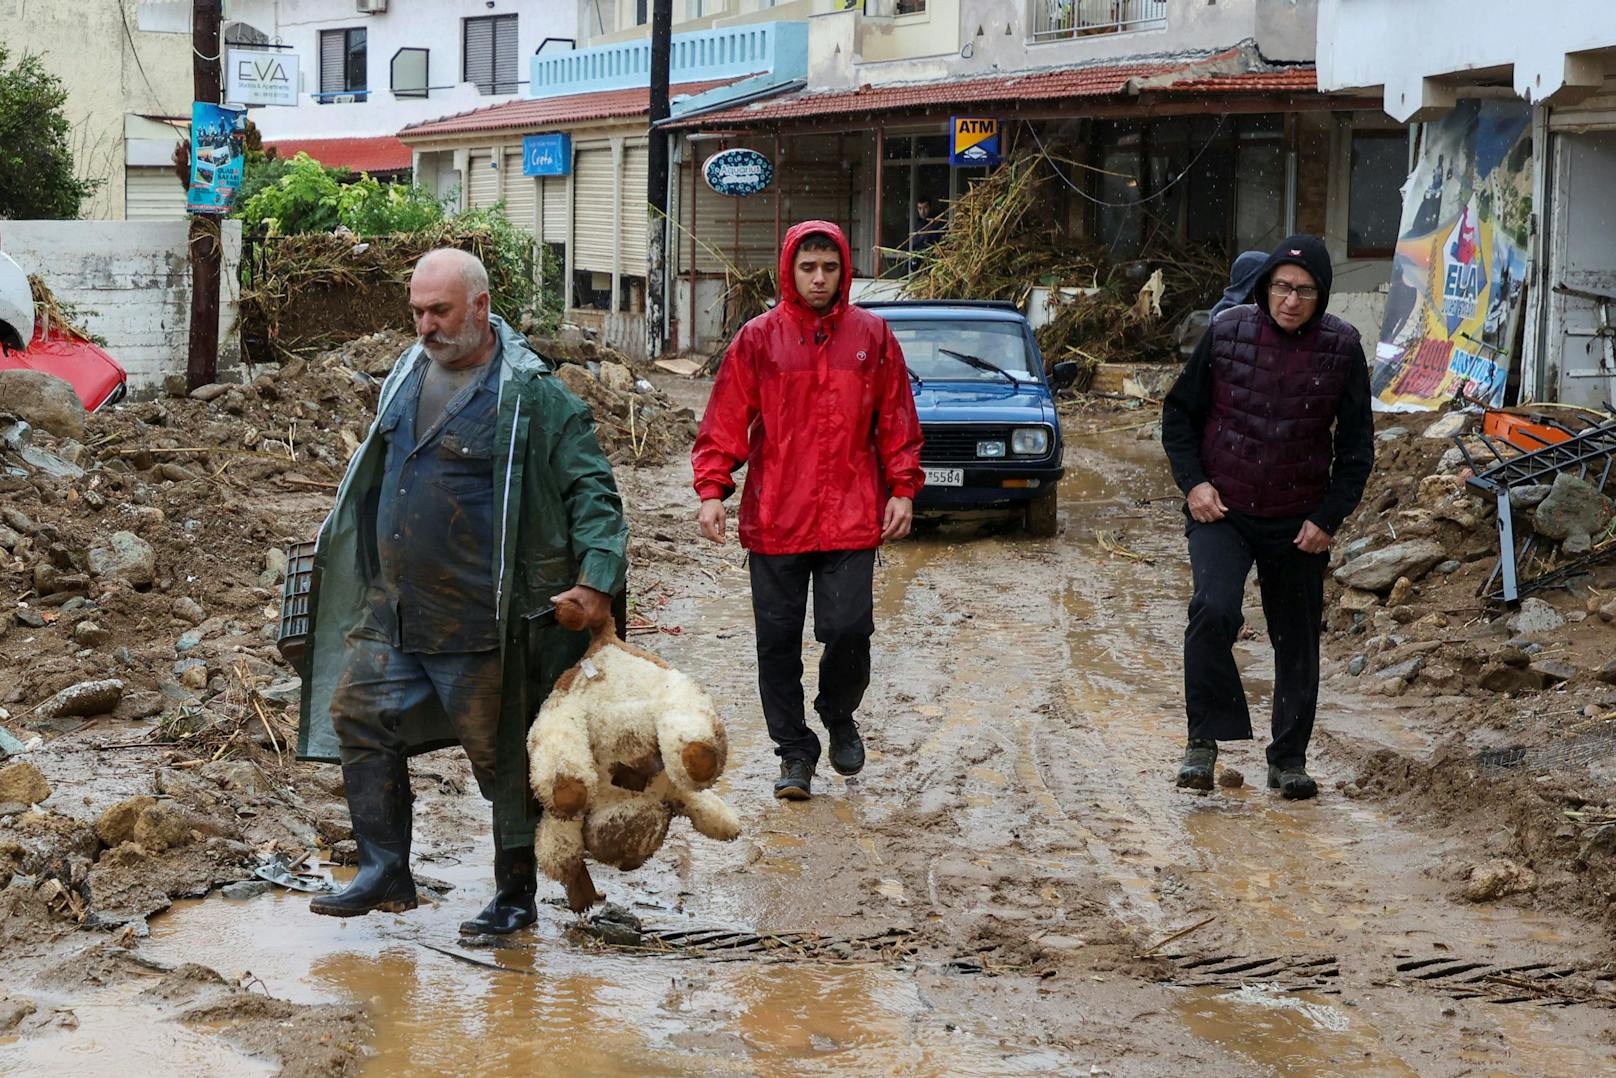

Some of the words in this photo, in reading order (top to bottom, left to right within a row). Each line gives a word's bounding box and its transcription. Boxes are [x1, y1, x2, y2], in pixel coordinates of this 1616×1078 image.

[239, 58, 289, 82] EVA
[959, 120, 994, 133] ATM
[531, 148, 553, 166] Creta
[719, 163, 761, 176] Aquarius
[1443, 263, 1477, 299] ELA
[933, 471, 960, 483] 5584
